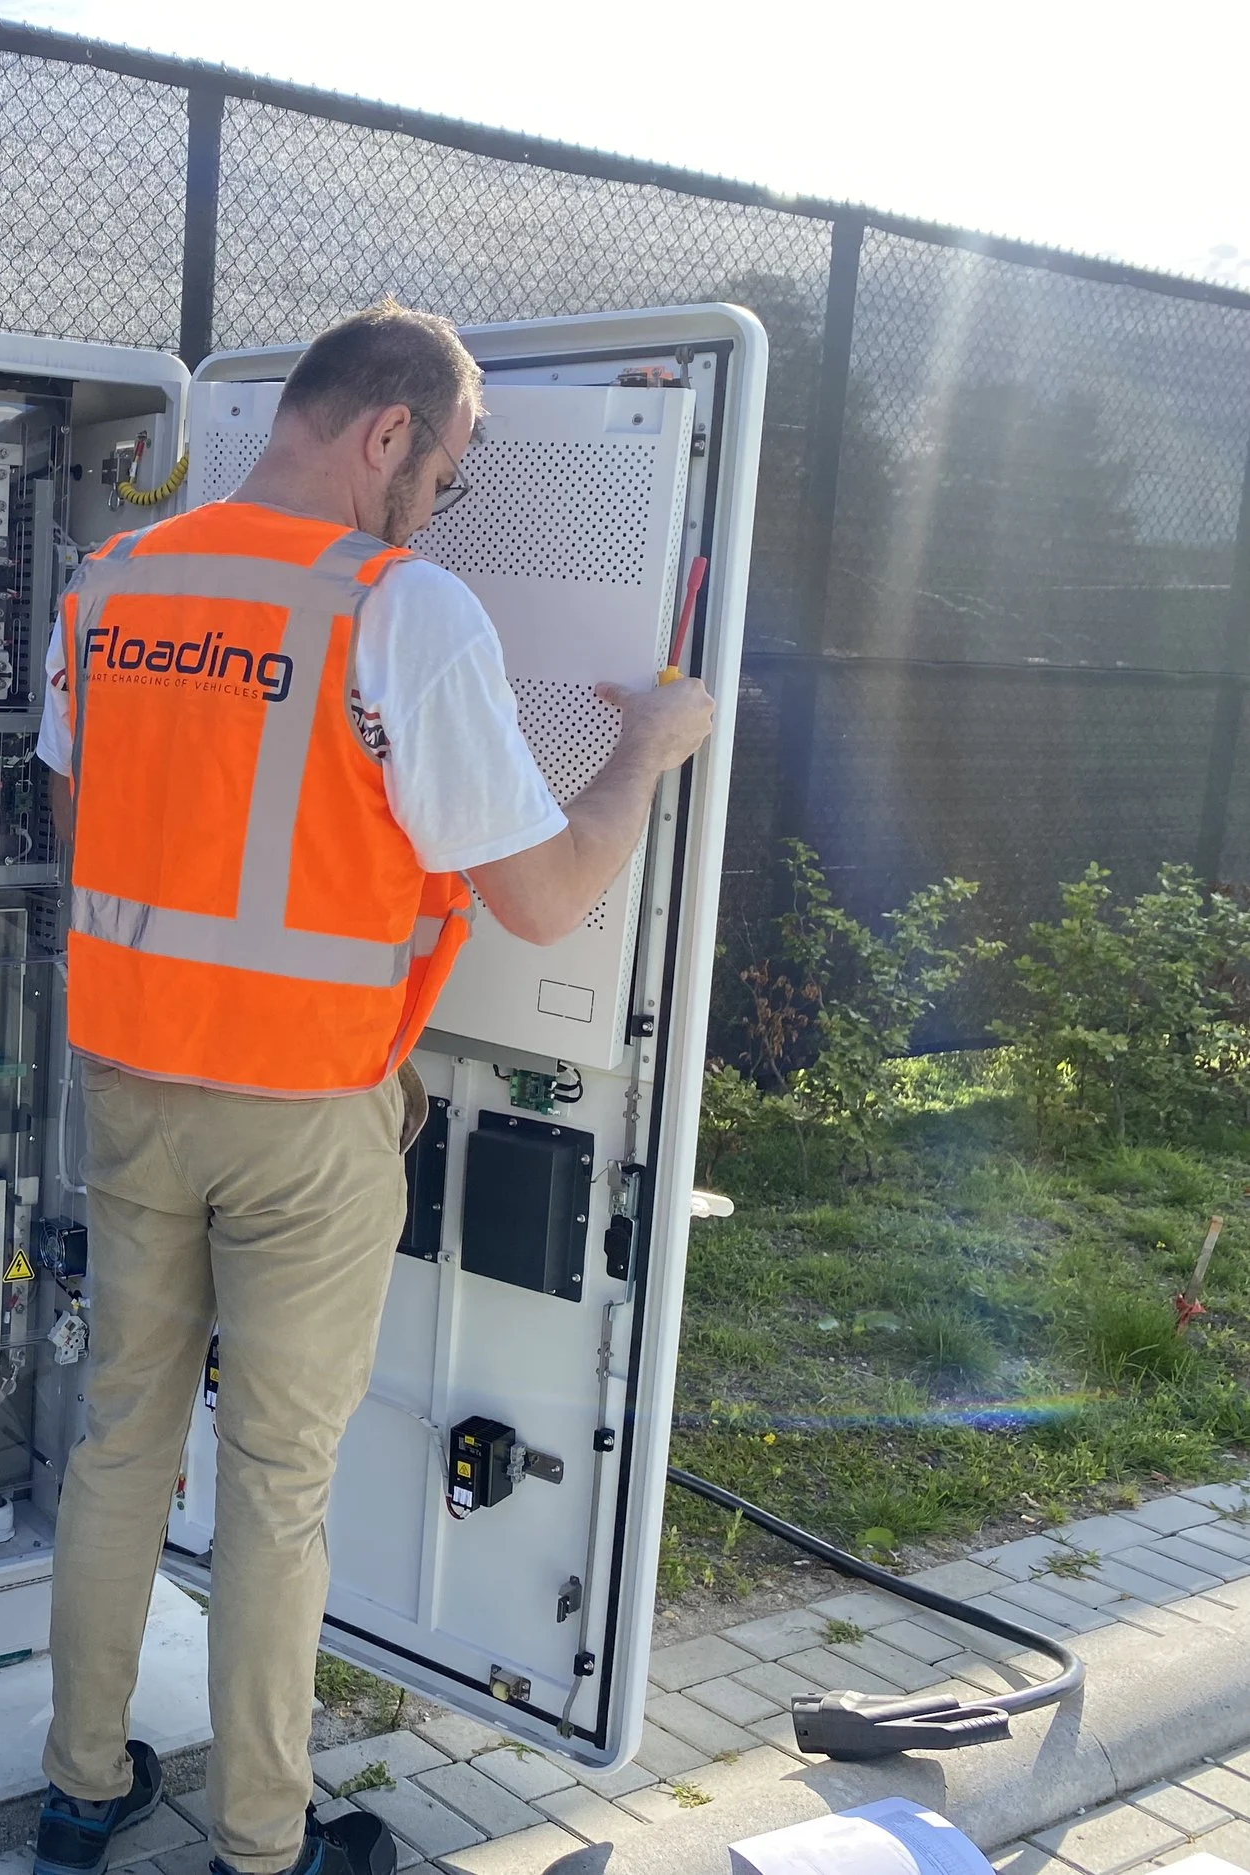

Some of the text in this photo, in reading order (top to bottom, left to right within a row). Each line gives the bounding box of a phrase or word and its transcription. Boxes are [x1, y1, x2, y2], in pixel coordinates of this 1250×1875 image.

[83, 626, 294, 702] Floading
[111, 673, 170, 688] CHARGING
[174, 677, 188, 688] OF
[194, 681, 259, 700] VEHICLES
